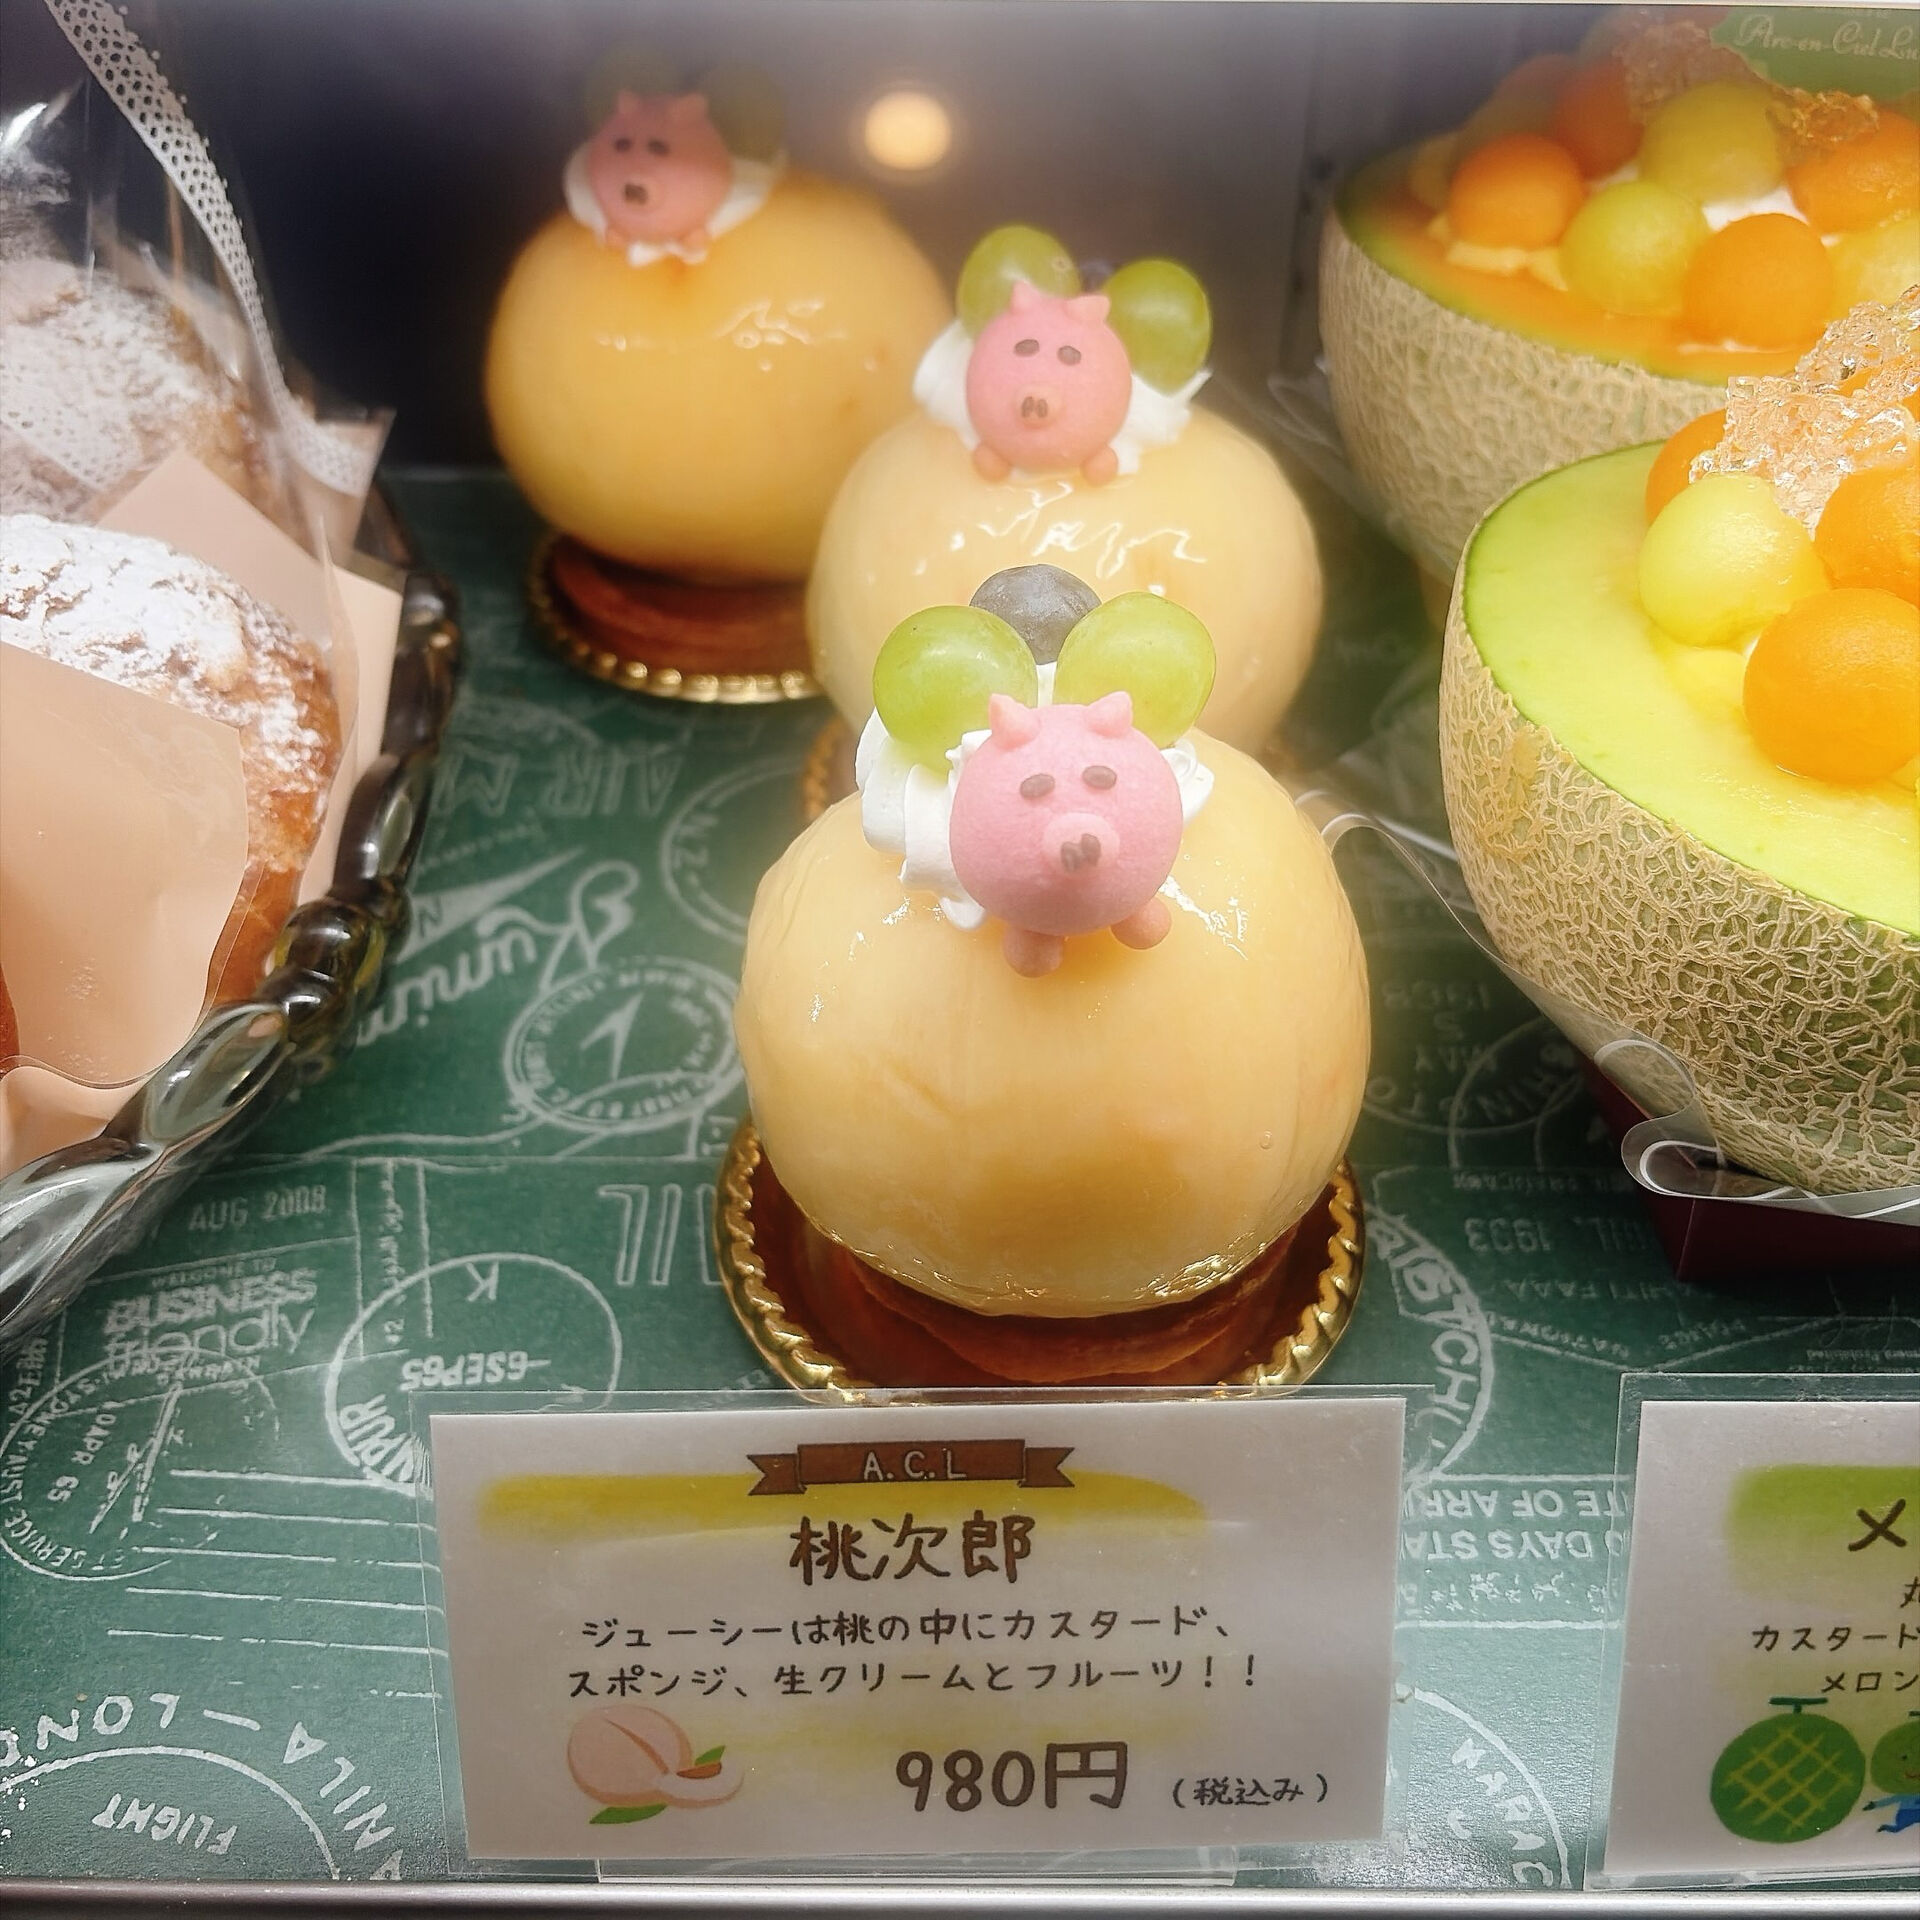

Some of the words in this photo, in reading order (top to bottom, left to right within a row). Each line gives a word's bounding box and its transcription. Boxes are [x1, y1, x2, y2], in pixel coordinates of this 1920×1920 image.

[188, 1196, 248, 1232] AUG
[103, 1267, 319, 1336] BUSINESS
[464, 1261, 500, 1302] K
[863, 1446, 967, 1482] A.C.L
[1512, 1489, 1564, 1518] OF
[789, 1508, 1037, 1587] 桃次郎
[1486, 1528, 1594, 1561] DAYS
[581, 1605, 1231, 1649] ジューシーは桃の中にカスタード、
[1821, 1670, 1920, 1695] メロン
[895, 1740, 1129, 1813] 980円
[91, 1792, 239, 1856] FLIGHT
